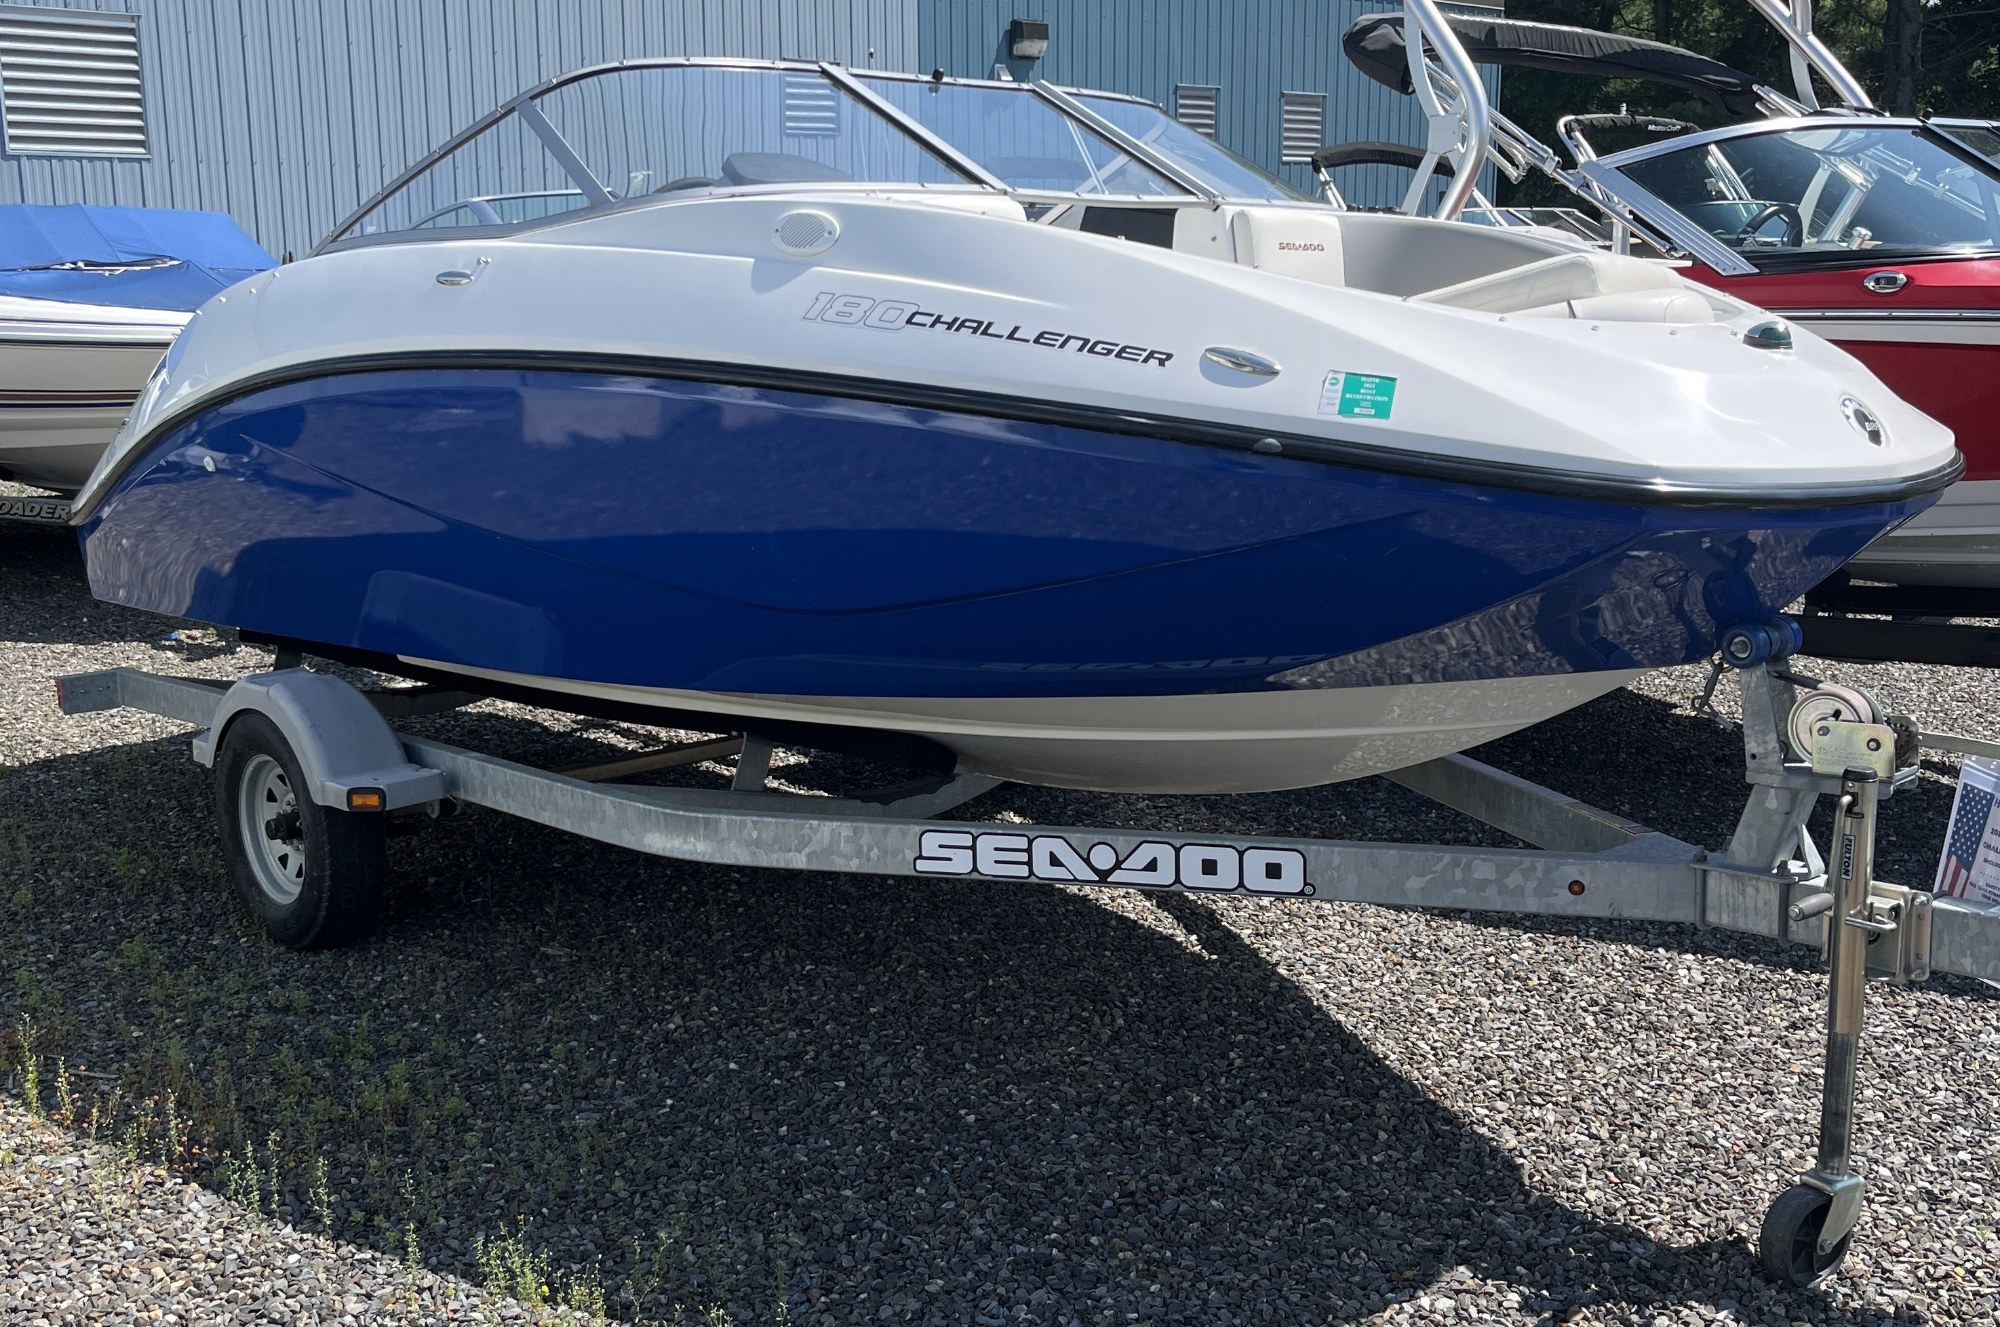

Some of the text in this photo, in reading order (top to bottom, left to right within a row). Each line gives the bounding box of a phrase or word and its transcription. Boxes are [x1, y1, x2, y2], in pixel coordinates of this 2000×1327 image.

[802, 291, 1174, 368] 180 CHALLENGER
[1345, 393, 1389, 401] REGISTRATION
[1842, 837, 1853, 877] FULTON
